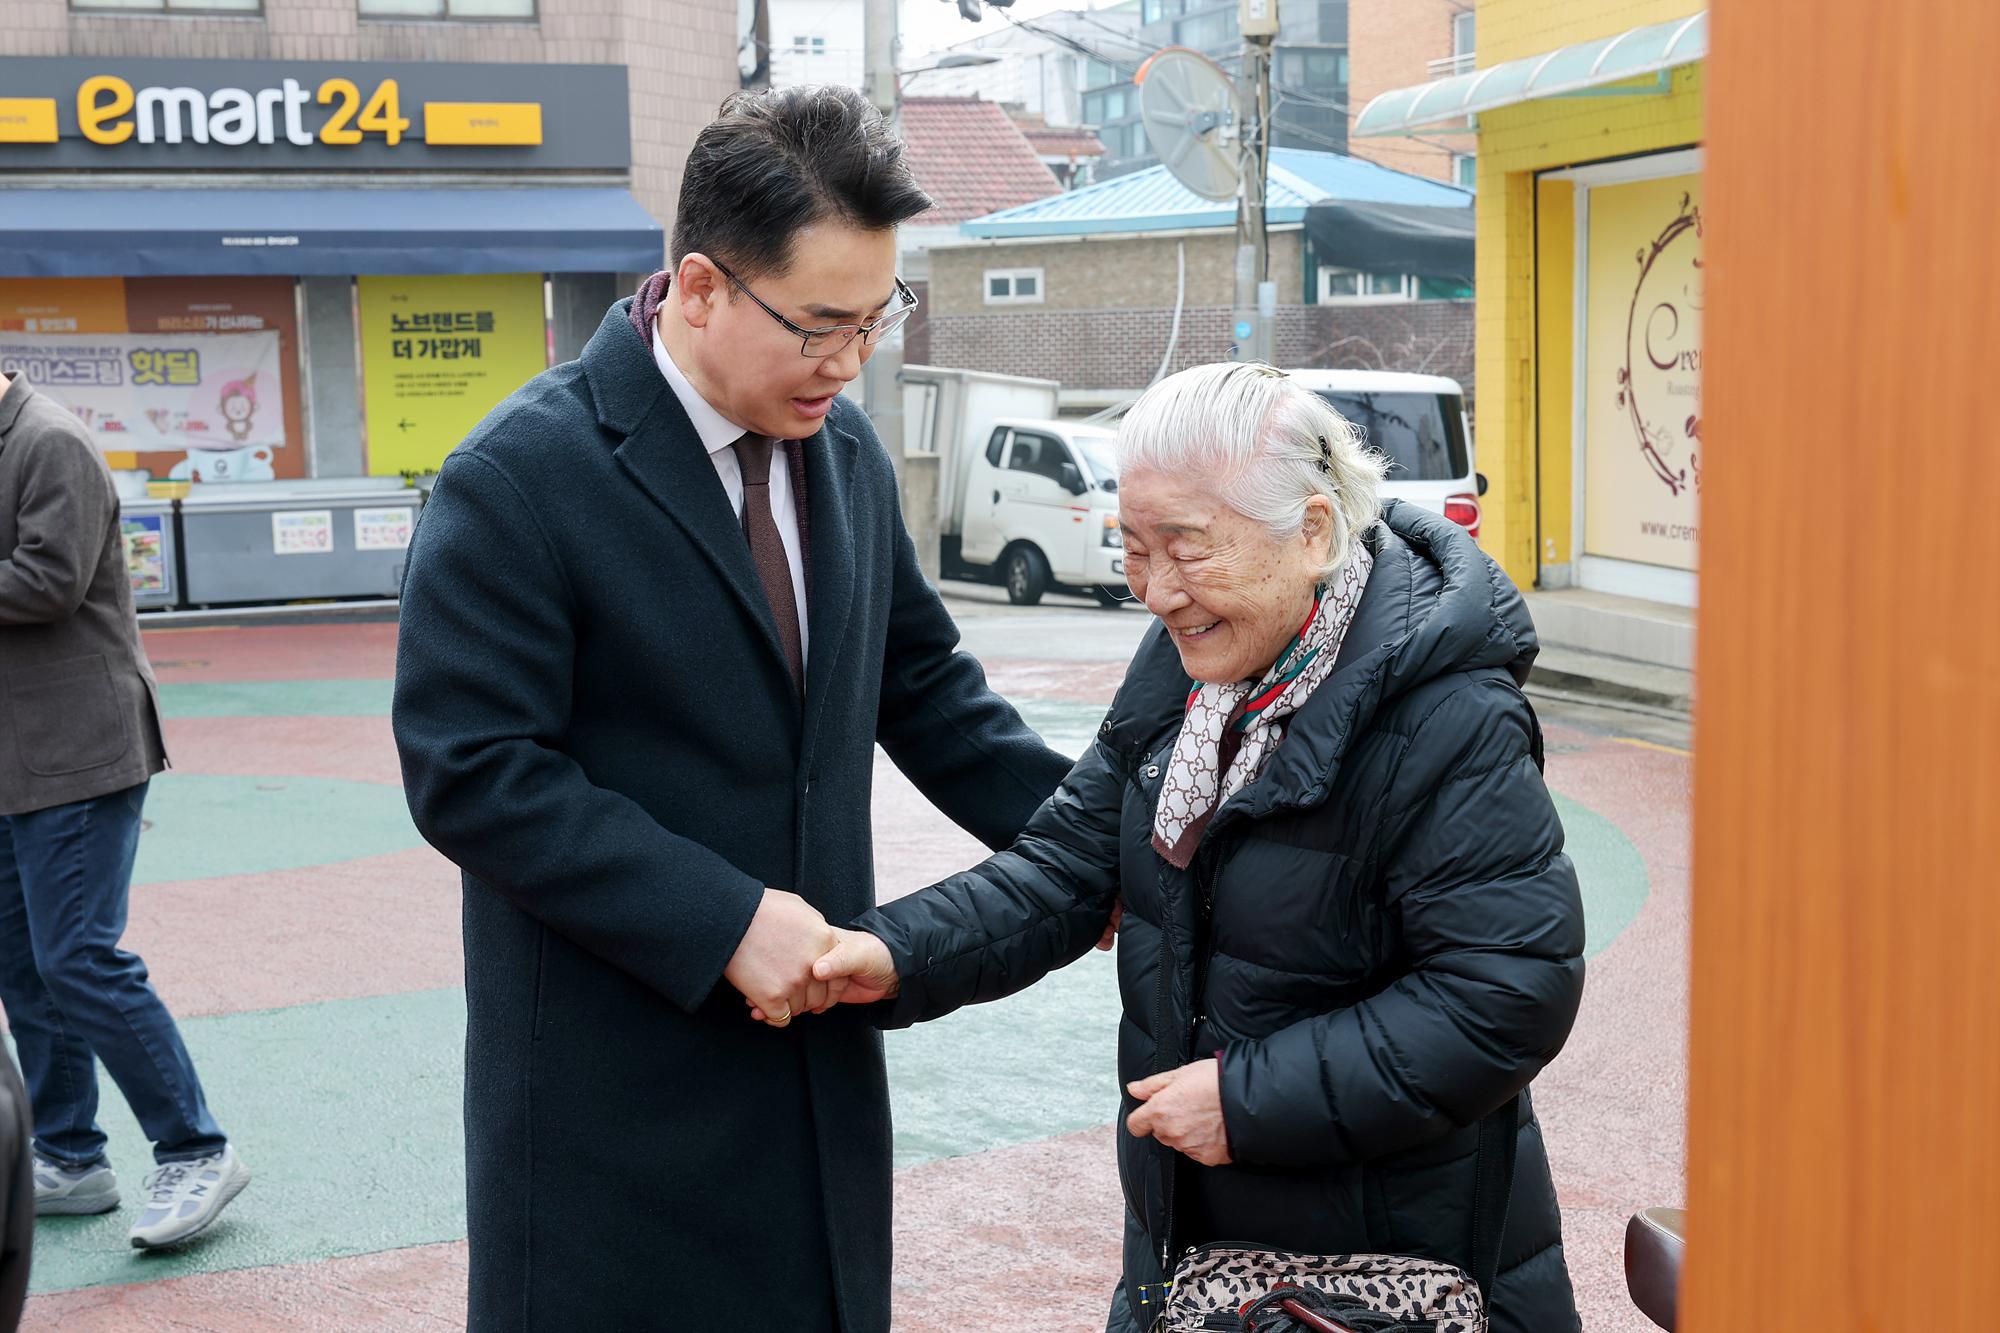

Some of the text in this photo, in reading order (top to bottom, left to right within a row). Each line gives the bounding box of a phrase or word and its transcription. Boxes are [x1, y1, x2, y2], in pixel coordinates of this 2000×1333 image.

[77, 75, 410, 146] emart24
[391, 311, 494, 333] 노브랜드를
[1646, 302, 1702, 371] Cre
[128, 348, 201, 386] 핫딜
[393, 338, 481, 359] 더 가깝게
